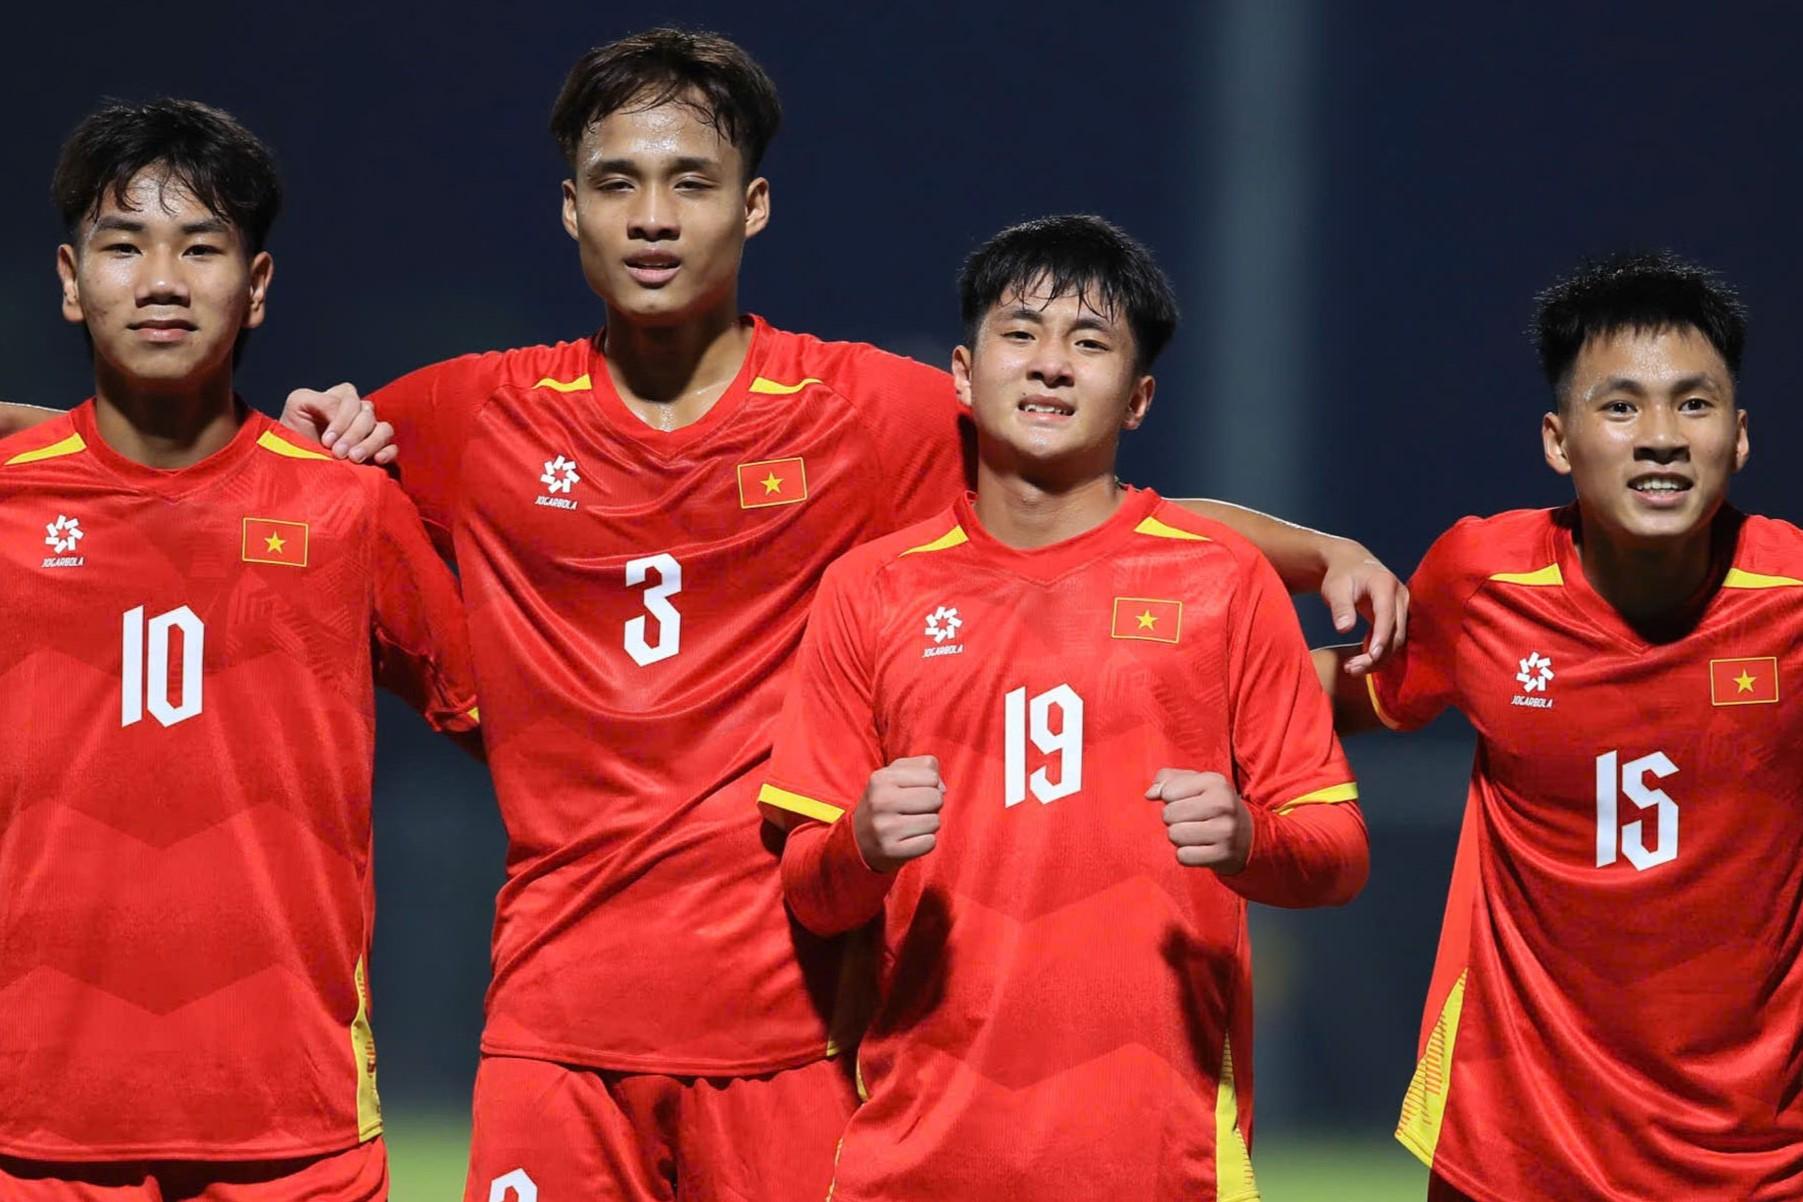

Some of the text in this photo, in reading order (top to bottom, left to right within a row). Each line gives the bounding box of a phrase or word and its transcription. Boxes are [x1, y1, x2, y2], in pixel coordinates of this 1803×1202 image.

[121, 605, 205, 728] 10
[623, 553, 682, 667] 3
[1004, 683, 1084, 809] 19
[1596, 750, 1679, 872] 15
